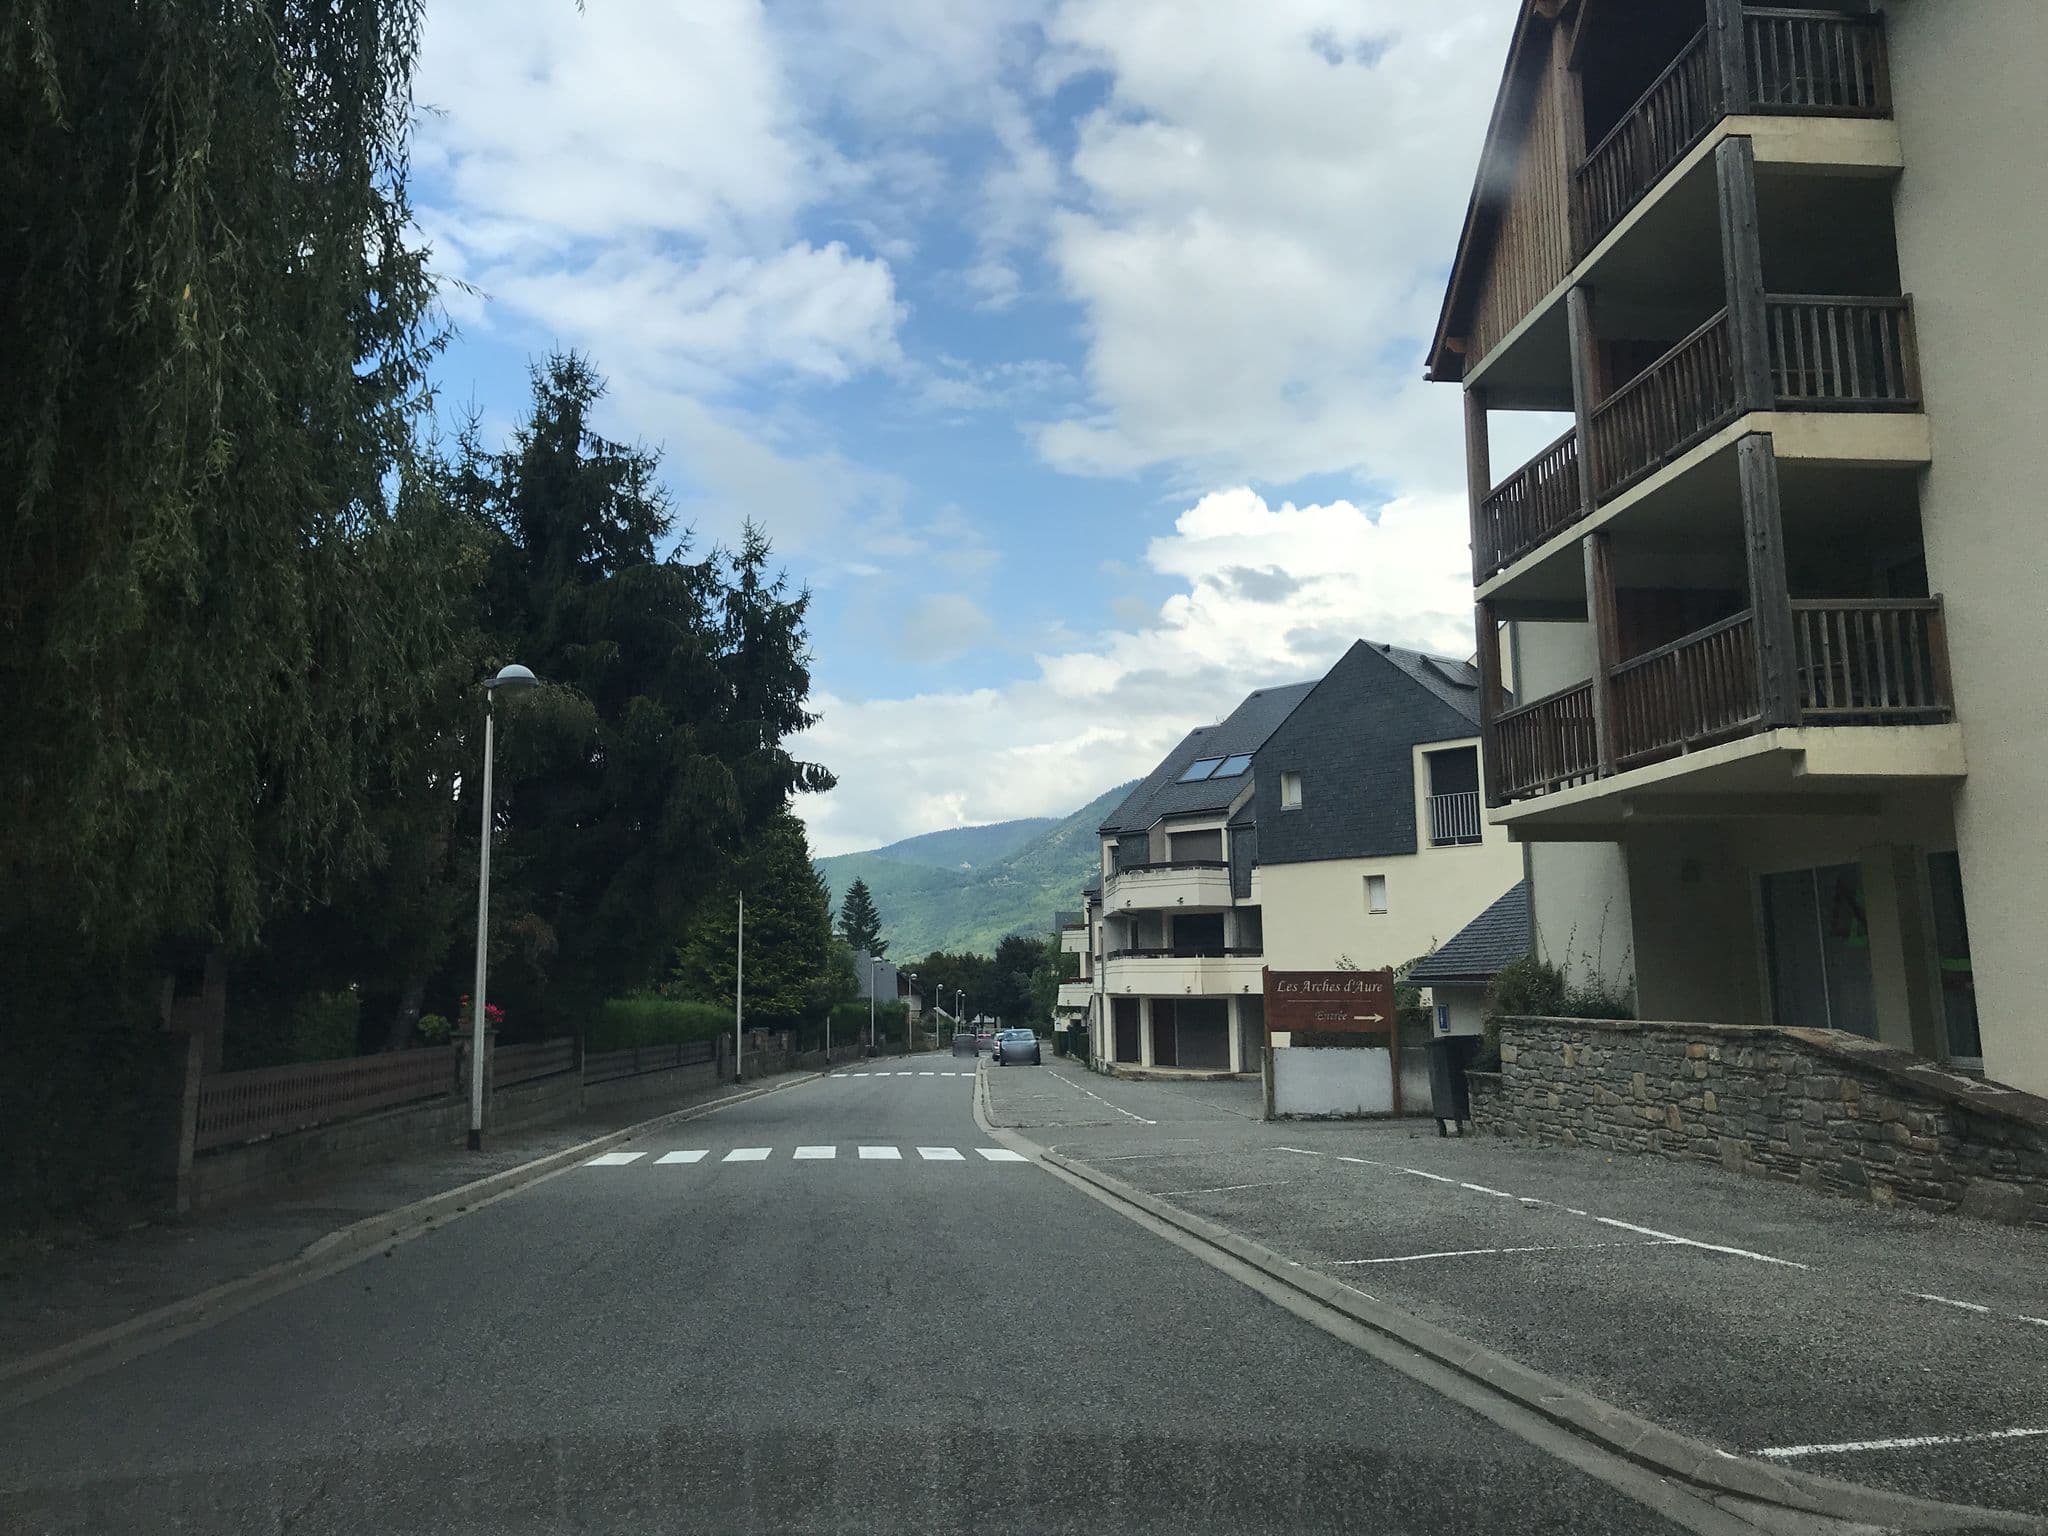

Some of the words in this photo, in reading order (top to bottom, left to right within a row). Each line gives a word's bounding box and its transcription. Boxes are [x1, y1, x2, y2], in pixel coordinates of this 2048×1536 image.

[1277, 980, 1298, 992] Les
[1299, 979, 1341, 993] Arches
[1344, 979, 1384, 993] d'Aure
